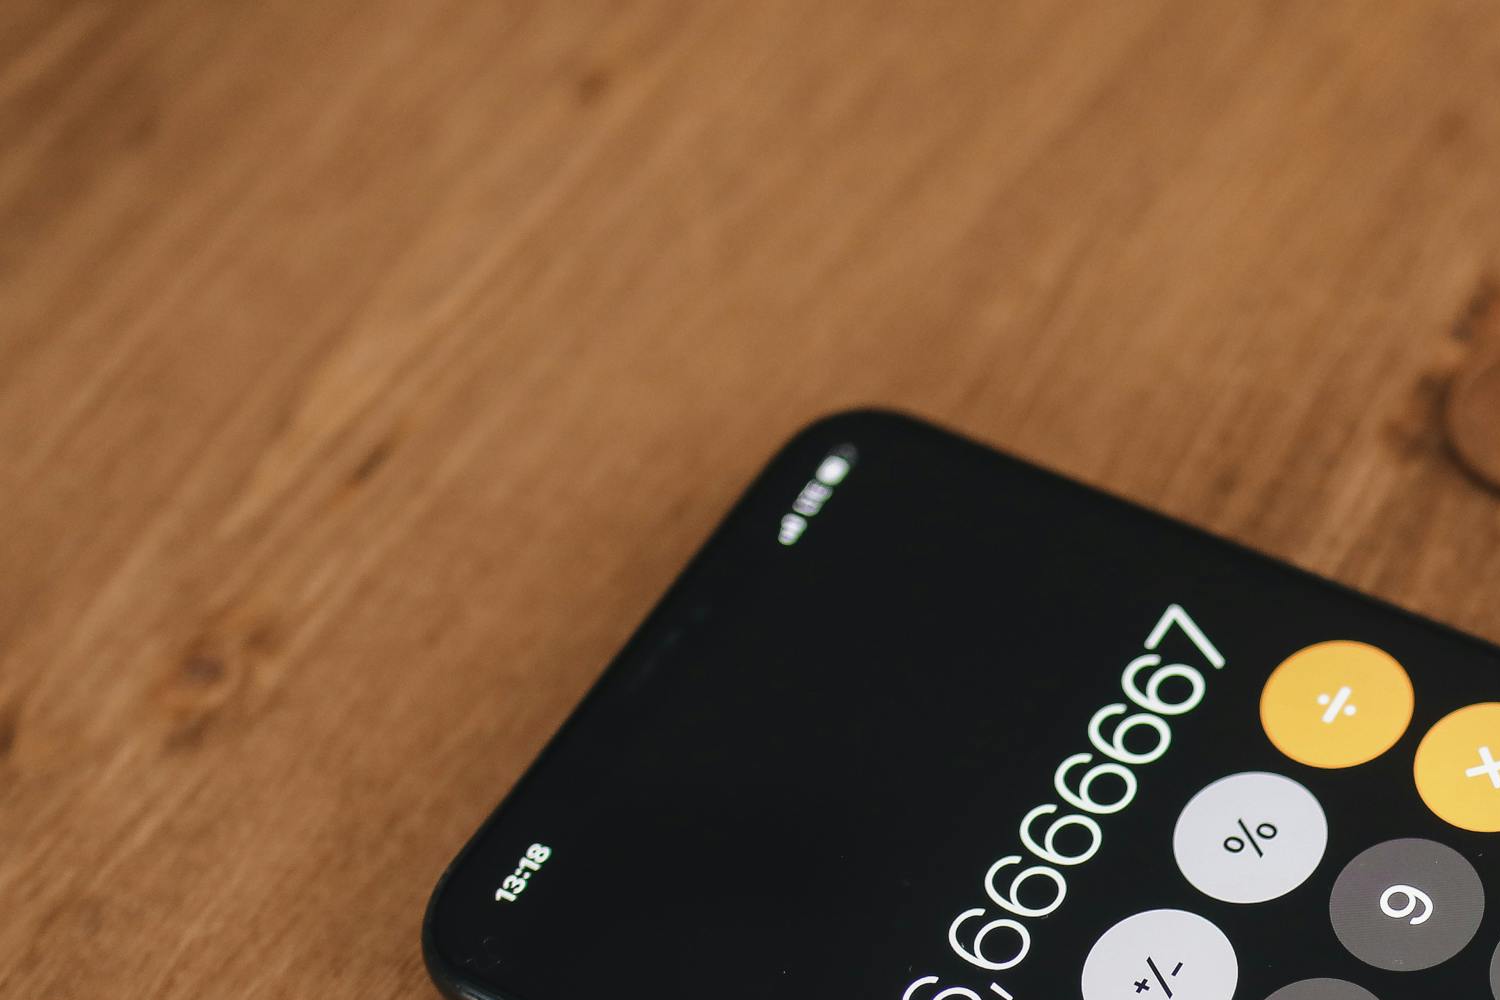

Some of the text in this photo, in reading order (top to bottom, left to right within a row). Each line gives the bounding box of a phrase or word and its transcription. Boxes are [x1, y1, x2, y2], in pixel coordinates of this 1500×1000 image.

[1223, 818, 1278, 859] %
[495, 842, 552, 903] 13:18
[1379, 884, 1434, 925] 9
[1133, 956, 1184, 1000] +/-
